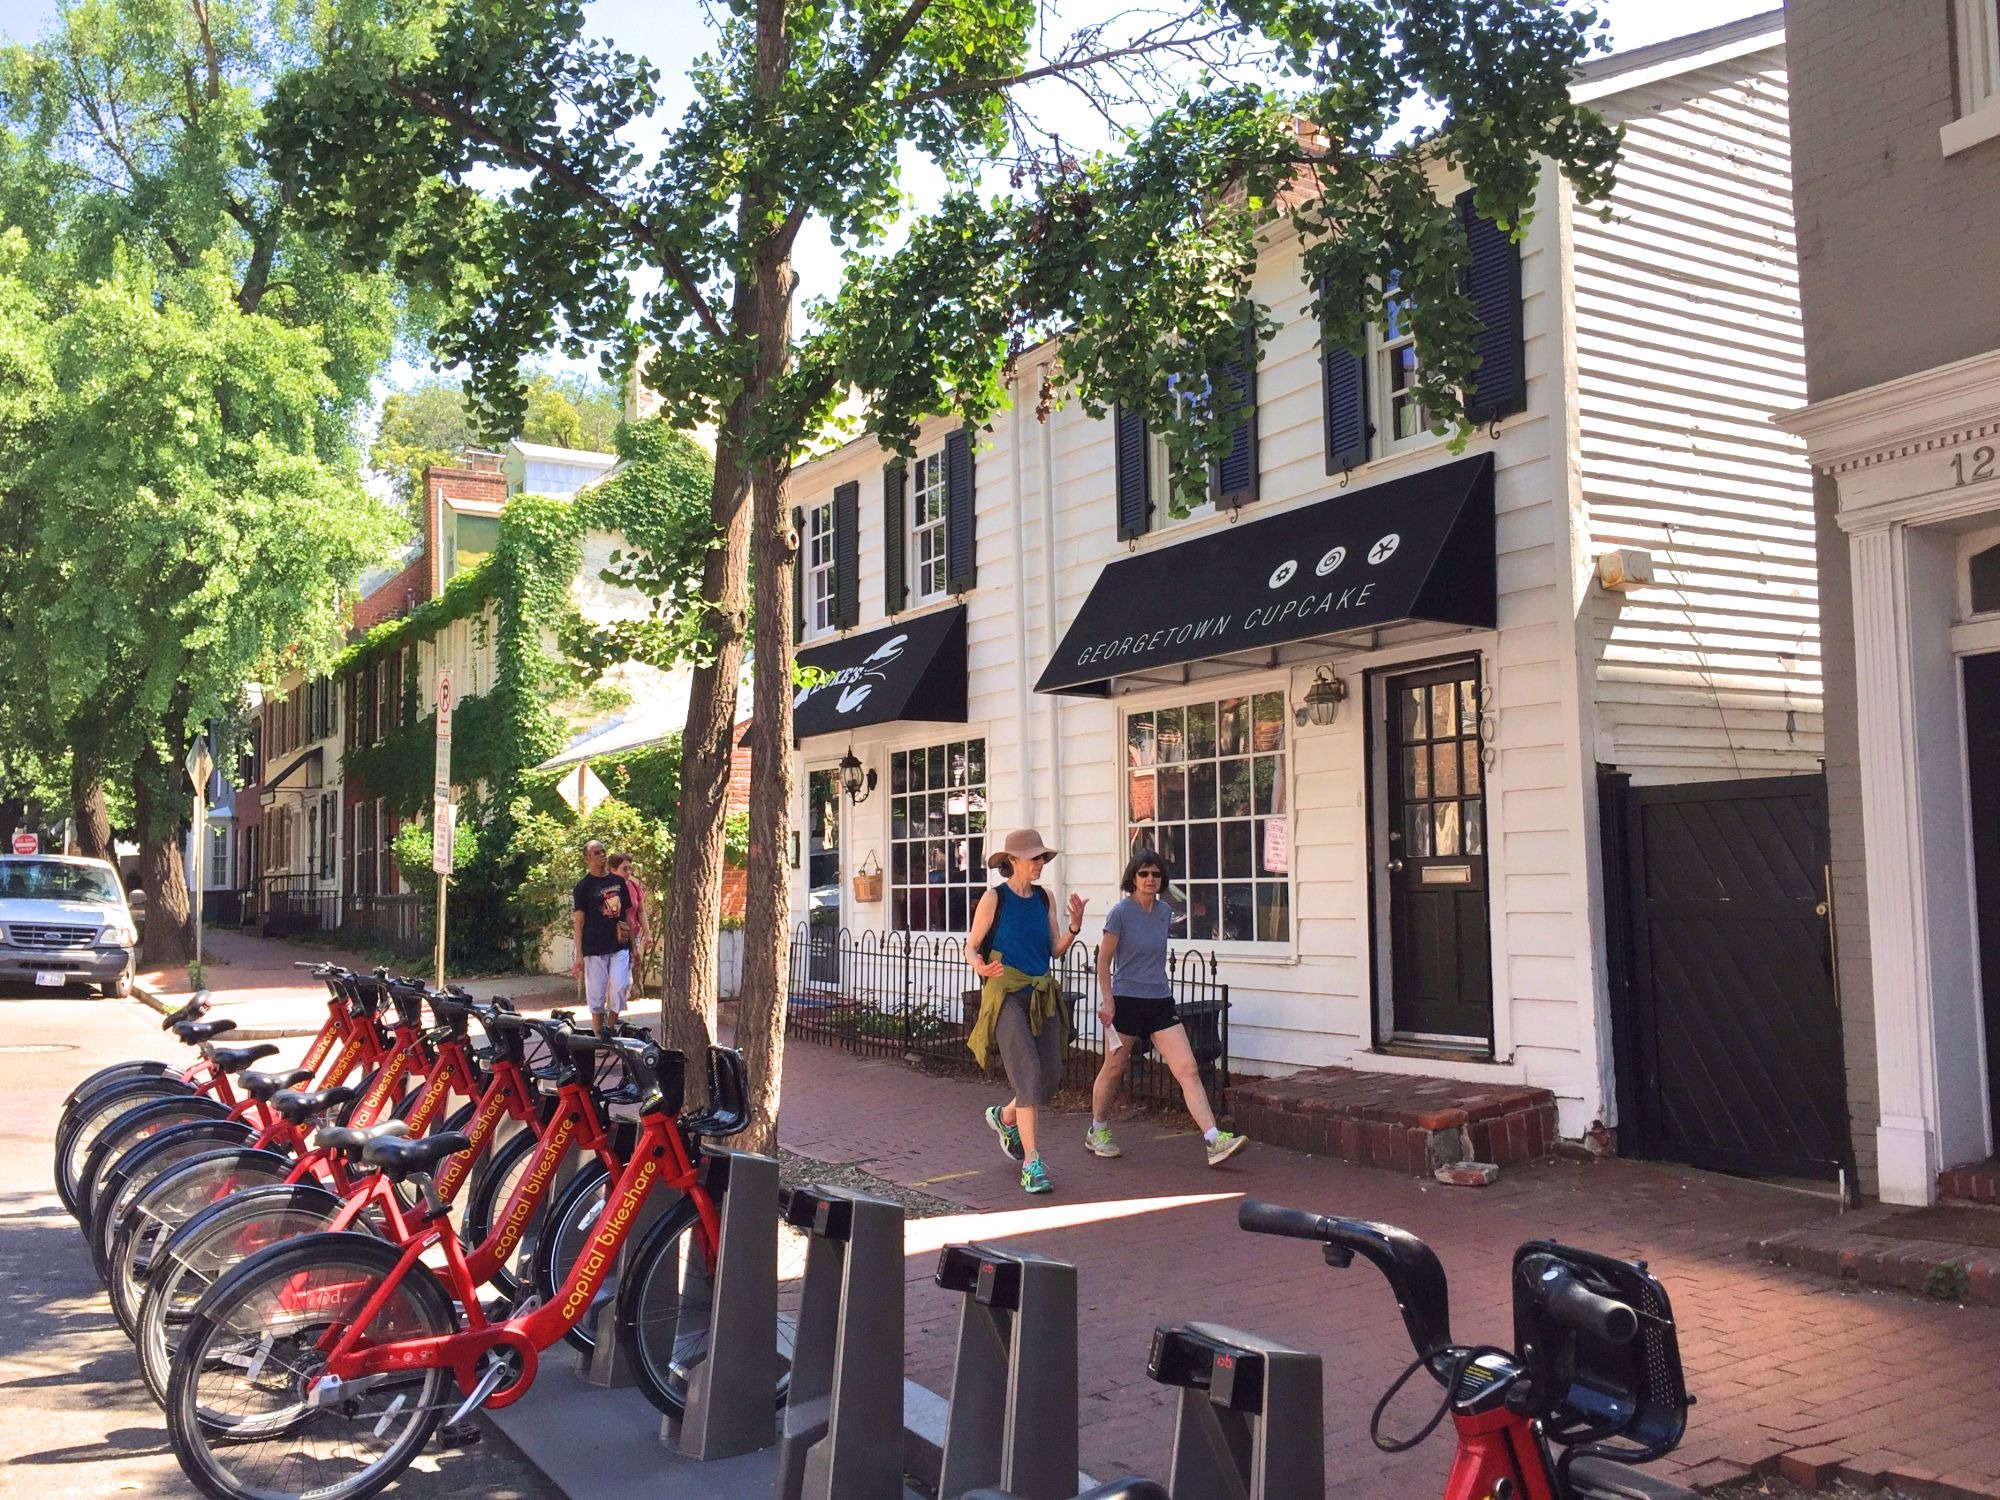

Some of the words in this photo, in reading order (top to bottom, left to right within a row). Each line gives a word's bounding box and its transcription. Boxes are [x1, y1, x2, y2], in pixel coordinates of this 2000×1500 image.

[1077, 615, 1231, 666] GEORGETOWN
[1244, 583, 1376, 630] CUPCAKE
[1480, 658, 1496, 773] 1209
[364, 1053, 405, 1108] bikeshare
[409, 1071, 449, 1132] bikeshare
[458, 1093, 504, 1159] bkeshare
[495, 1198, 531, 1260] capital
[522, 1118, 573, 1195] bikeshare
[562, 1250, 606, 1319] capital
[595, 1160, 656, 1247] bikeshare
